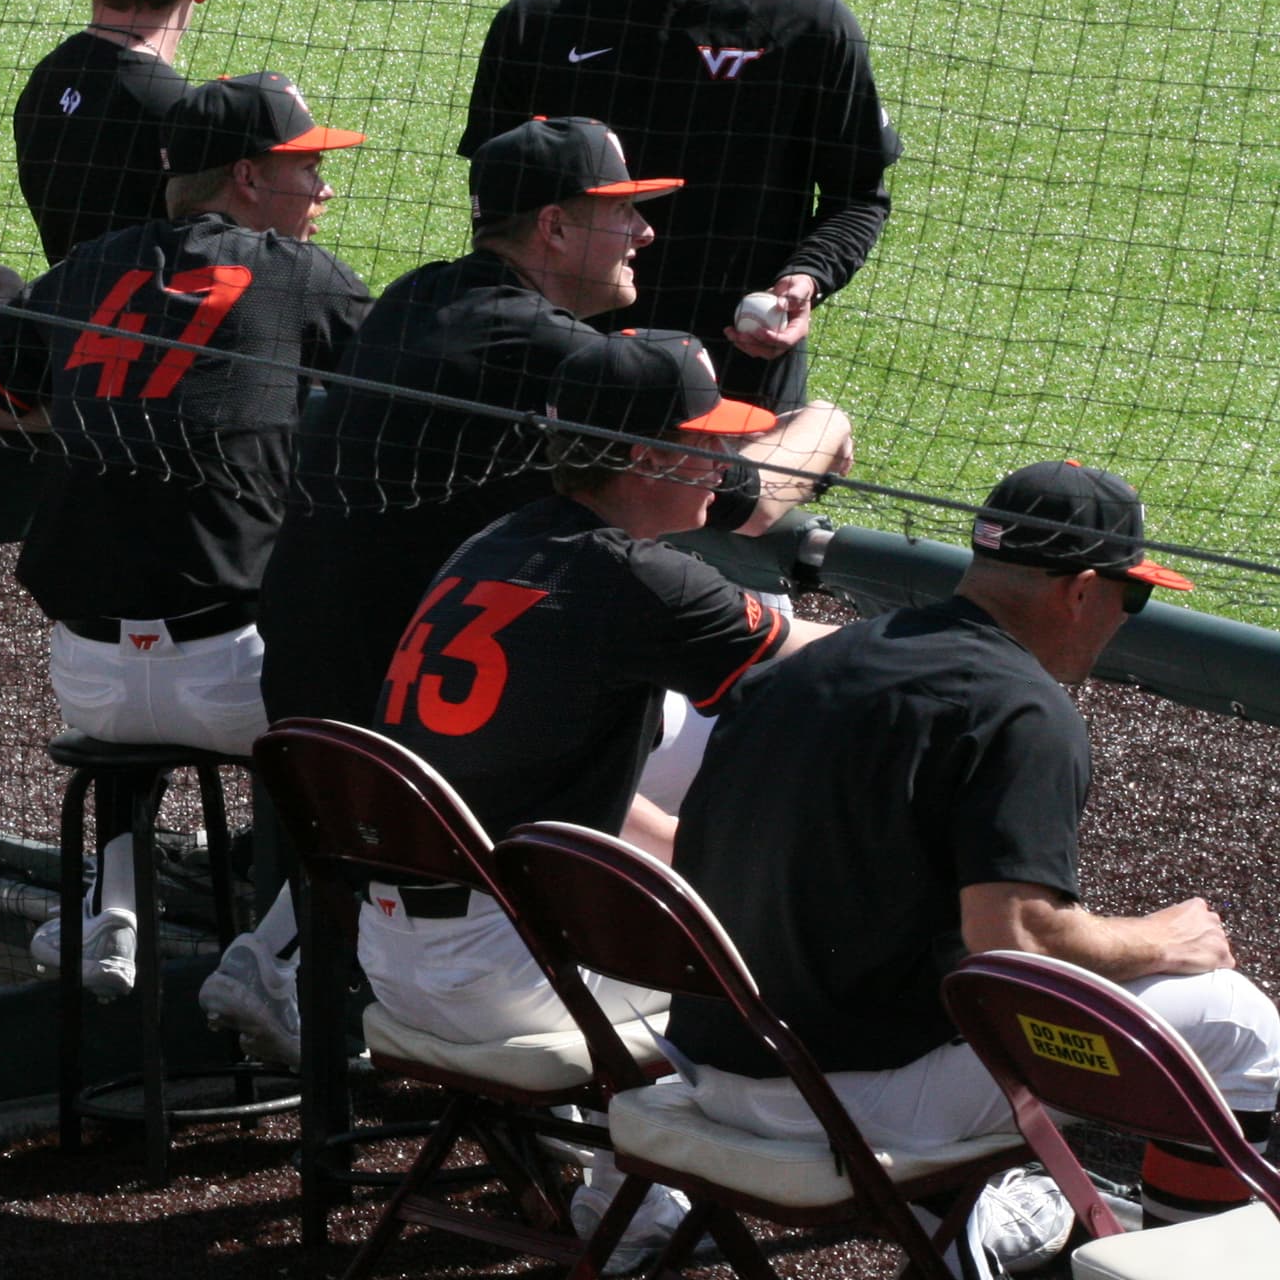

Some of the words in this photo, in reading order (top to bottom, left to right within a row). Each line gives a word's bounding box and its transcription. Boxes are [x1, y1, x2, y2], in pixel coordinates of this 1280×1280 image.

[697, 45, 765, 80] VT
[64, 265, 253, 400] 47
[127, 632, 160, 651] VT
[383, 576, 551, 737] 43
[1029, 1022, 1055, 1042] DO
[1057, 1031, 1096, 1052] NOT
[1032, 1038, 1111, 1071] REMOVE
